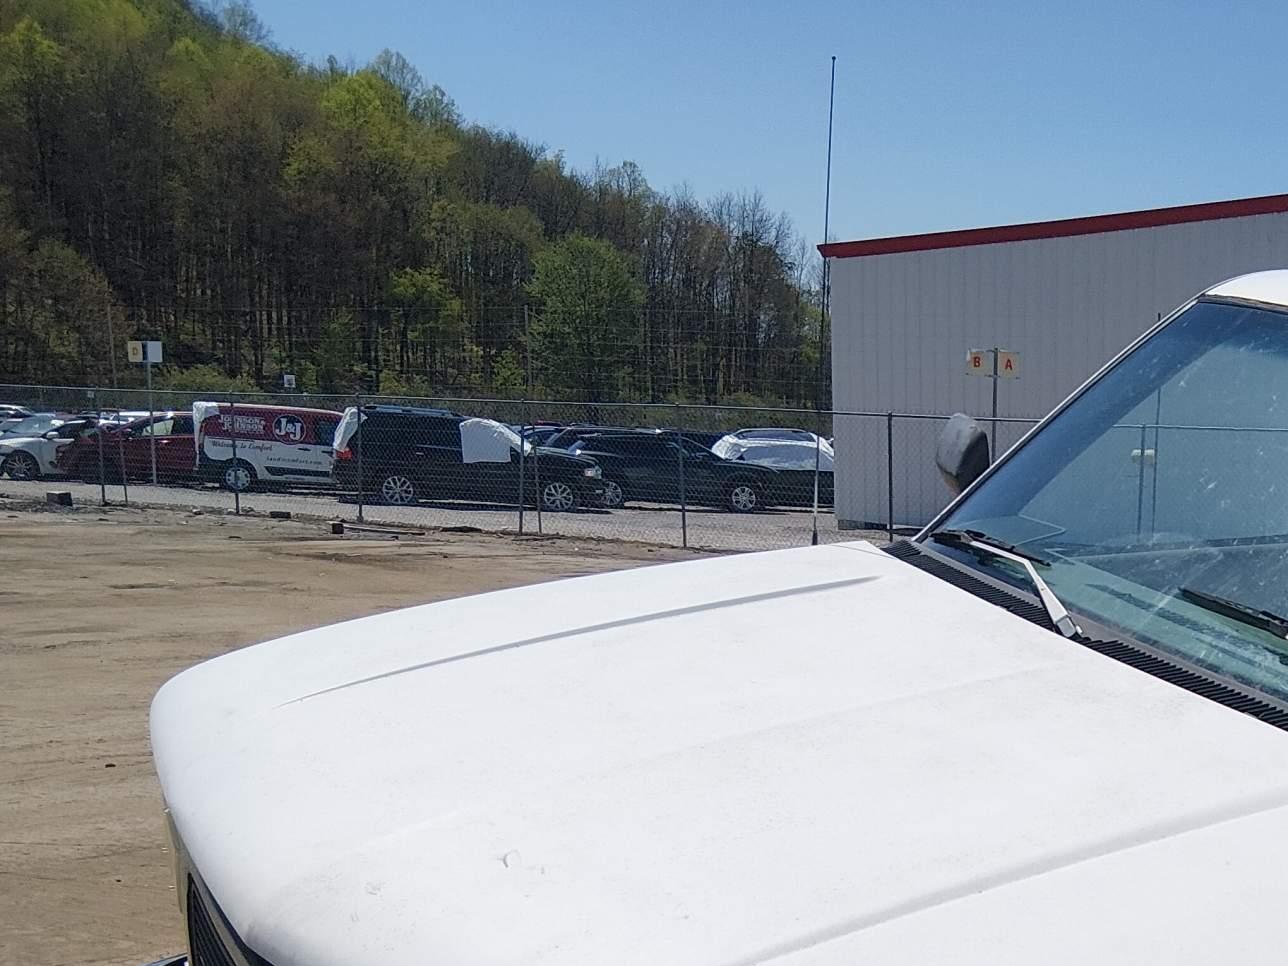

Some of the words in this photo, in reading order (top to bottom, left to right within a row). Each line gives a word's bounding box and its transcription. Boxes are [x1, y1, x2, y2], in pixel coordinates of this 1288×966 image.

[973, 356, 981, 367] B
[1005, 358, 1013, 370] A
[275, 418, 302, 440] J&J
